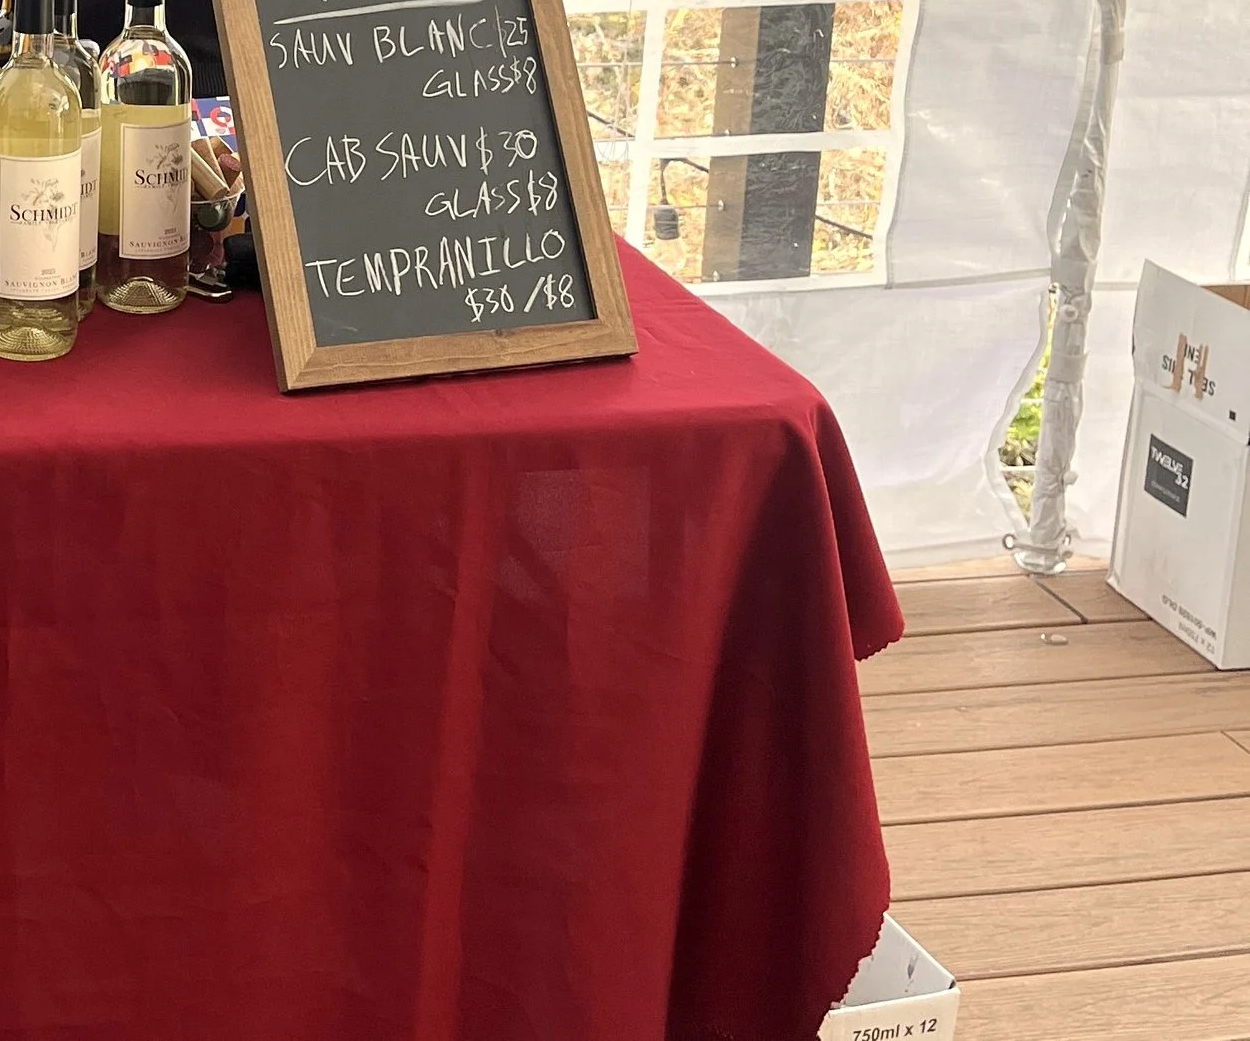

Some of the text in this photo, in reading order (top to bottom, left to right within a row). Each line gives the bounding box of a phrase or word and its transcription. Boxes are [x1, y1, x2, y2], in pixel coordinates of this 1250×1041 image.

[268, 29, 354, 69] SAUV
[373, 14, 492, 61] BLANC
[285, 126, 538, 186] CAB SAUV $30
[10, 202, 78, 222] SCHMIDT
[424, 180, 521, 221] GLASS
[129, 239, 178, 248] SAUVIGNON
[305, 228, 566, 298] TEMPRANILLO
[5, 279, 57, 288] SAUVIGNON
[464, 287, 514, 323] $30
[1174, 471, 1190, 490] 32
[852, 1018, 938, 1041] 750ml x 12
